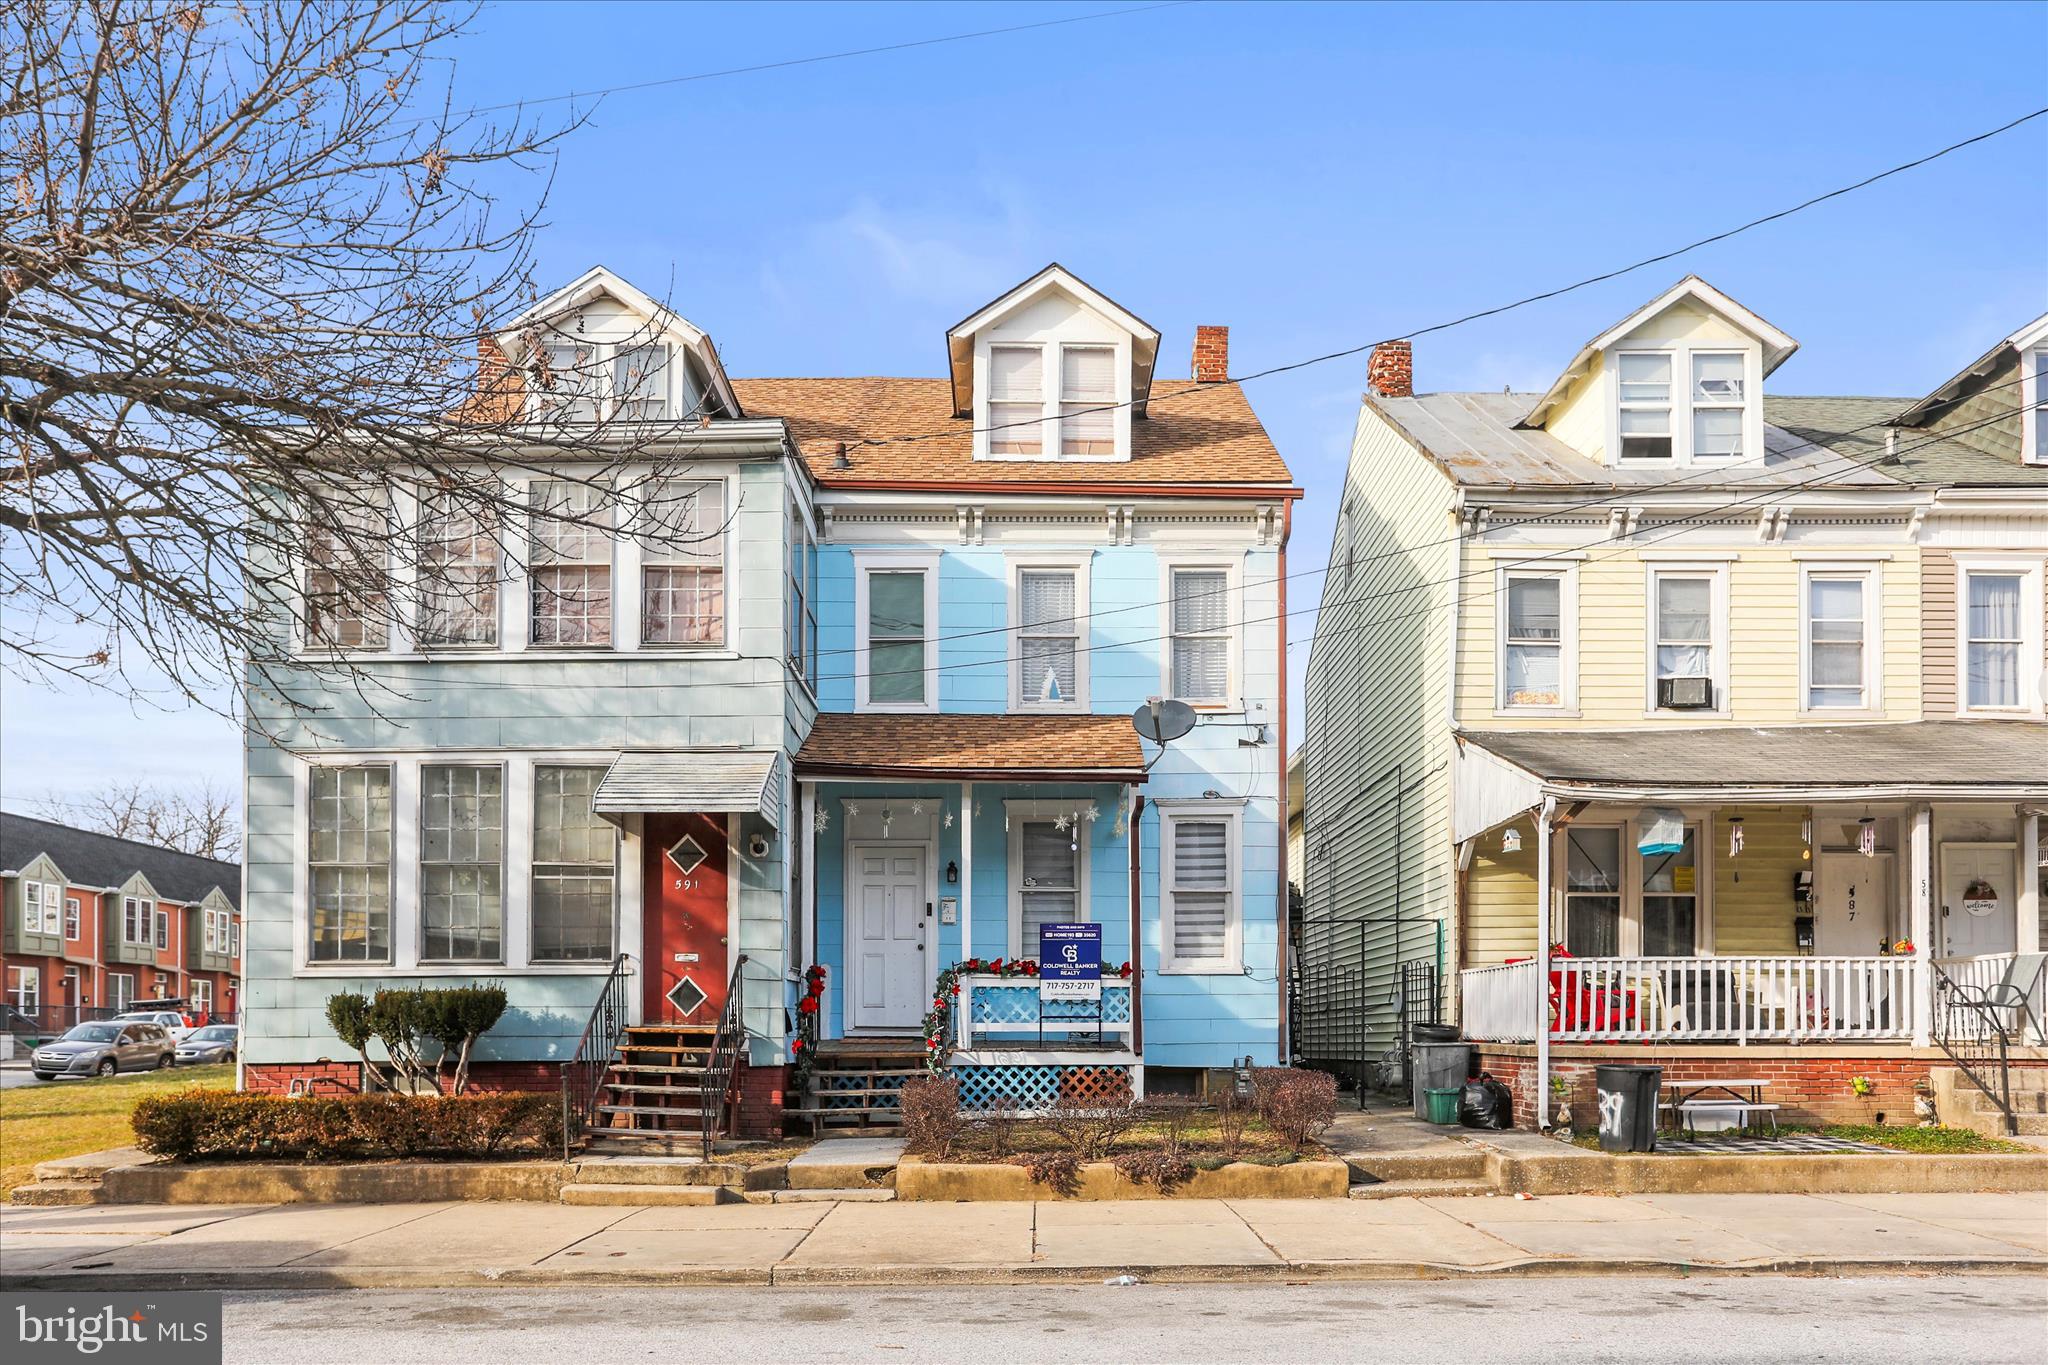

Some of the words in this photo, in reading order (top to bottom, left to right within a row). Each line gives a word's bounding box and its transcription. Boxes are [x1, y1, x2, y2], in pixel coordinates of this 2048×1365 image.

[675, 879, 699, 890] 591
[1966, 900, 1995, 912] welcome
[1046, 982, 1095, 990] 717-757-2717
